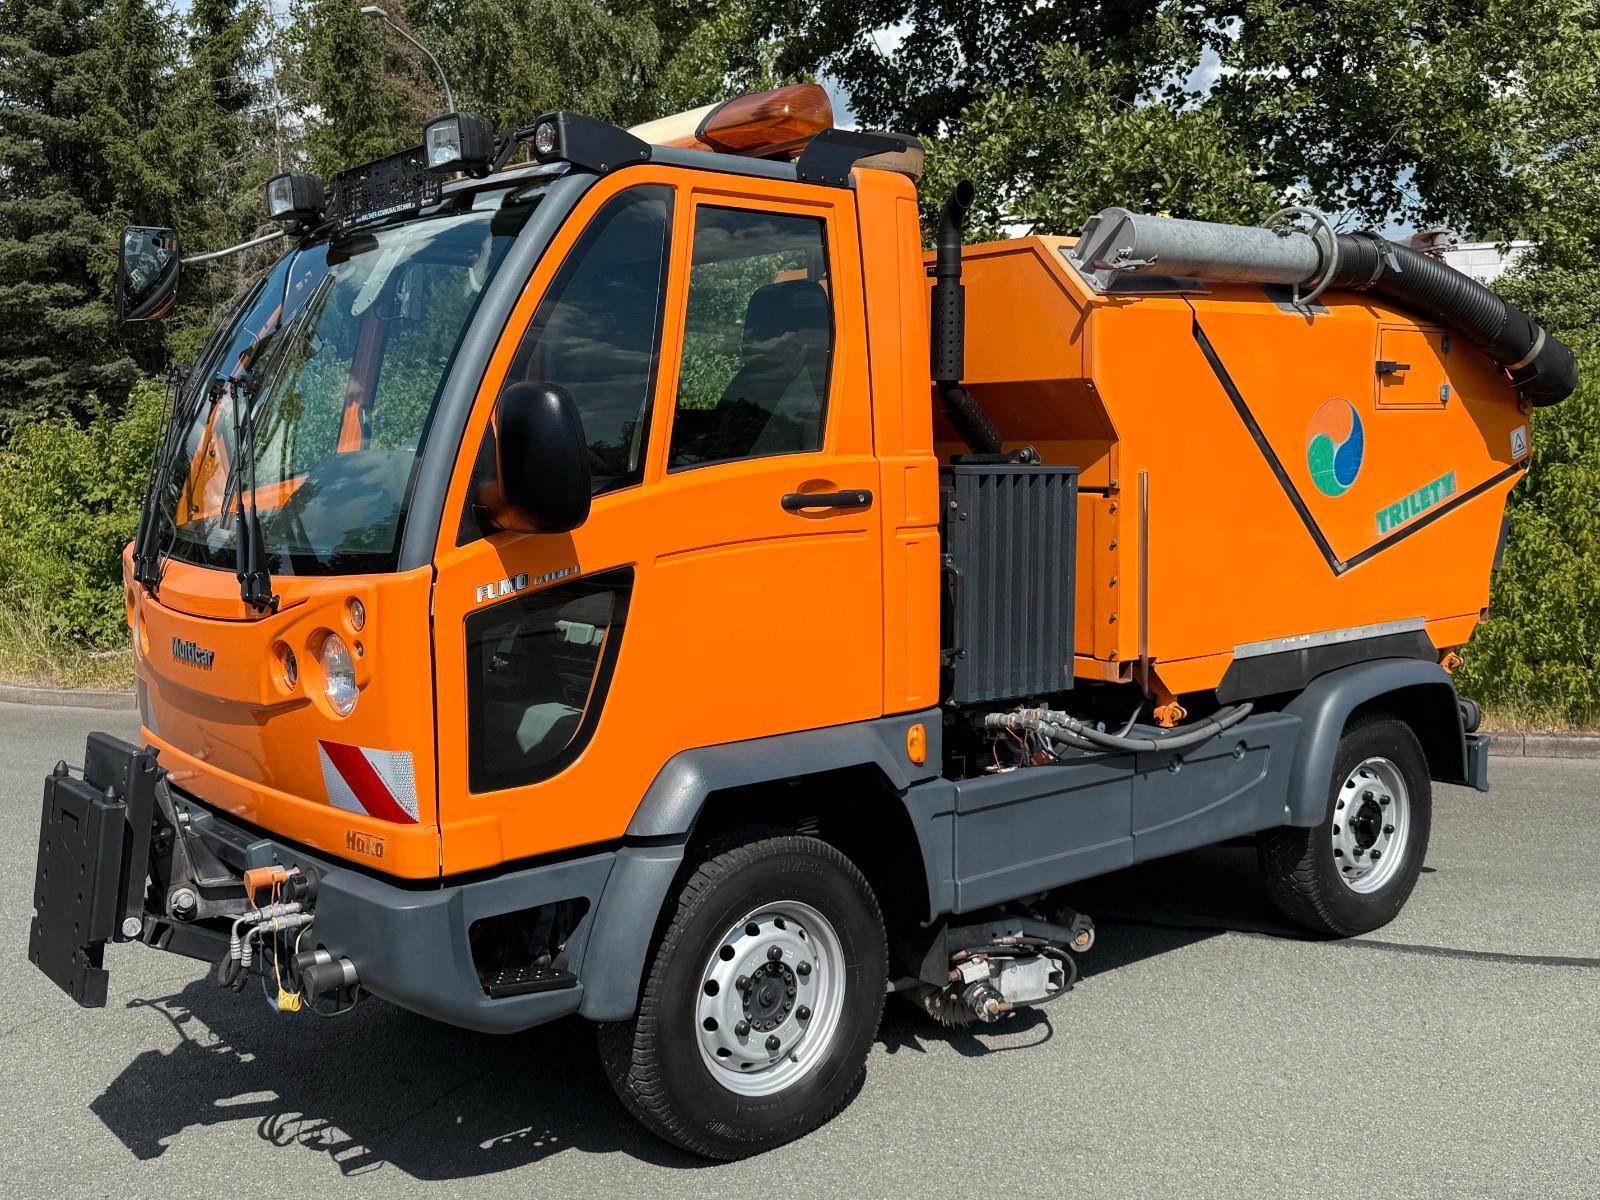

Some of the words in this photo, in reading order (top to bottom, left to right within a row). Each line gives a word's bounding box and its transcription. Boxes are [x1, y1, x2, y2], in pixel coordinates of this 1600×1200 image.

[1376, 470, 1456, 534] TRILETY
[476, 572, 528, 604] FUMO
[172, 636, 214, 668] Multicar
[346, 830, 385, 858] Hako
